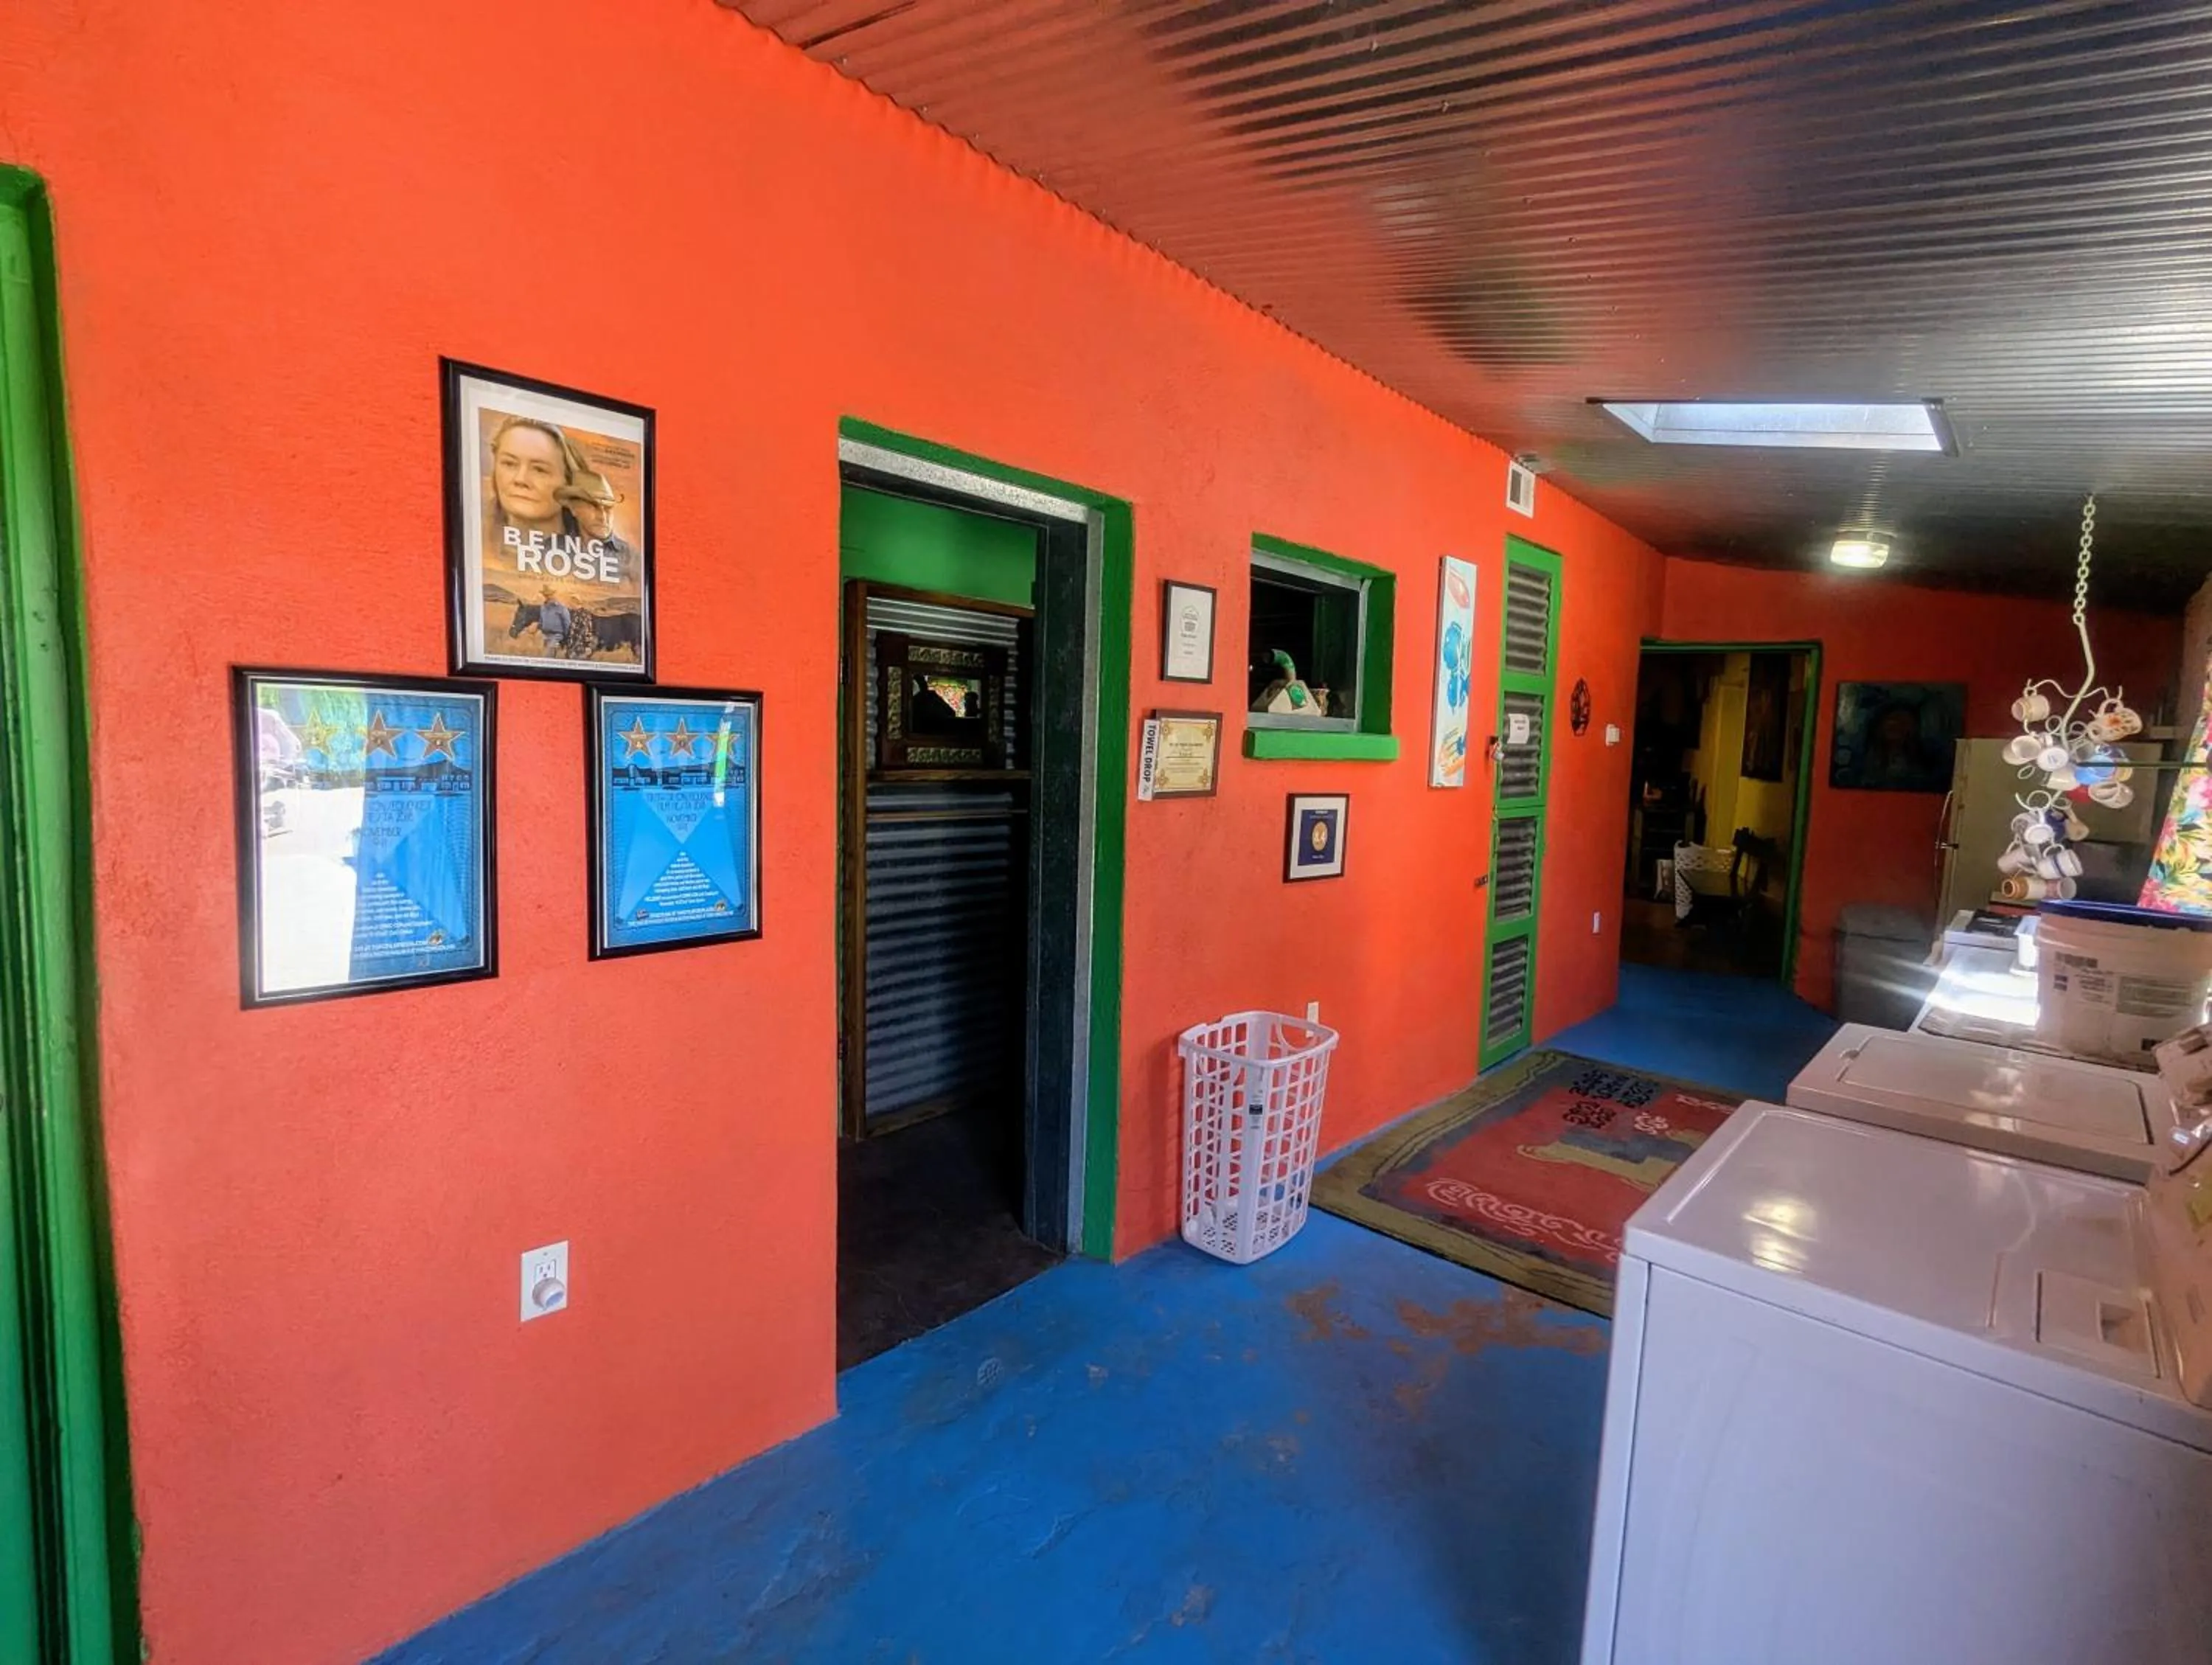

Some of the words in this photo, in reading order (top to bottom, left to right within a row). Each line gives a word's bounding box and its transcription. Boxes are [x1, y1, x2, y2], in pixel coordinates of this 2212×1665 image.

[504, 526, 604, 558] BEING
[518, 544, 620, 583] ROSE
[1145, 725, 1157, 755] TOWEL
[1143, 757, 1153, 783] DROP
